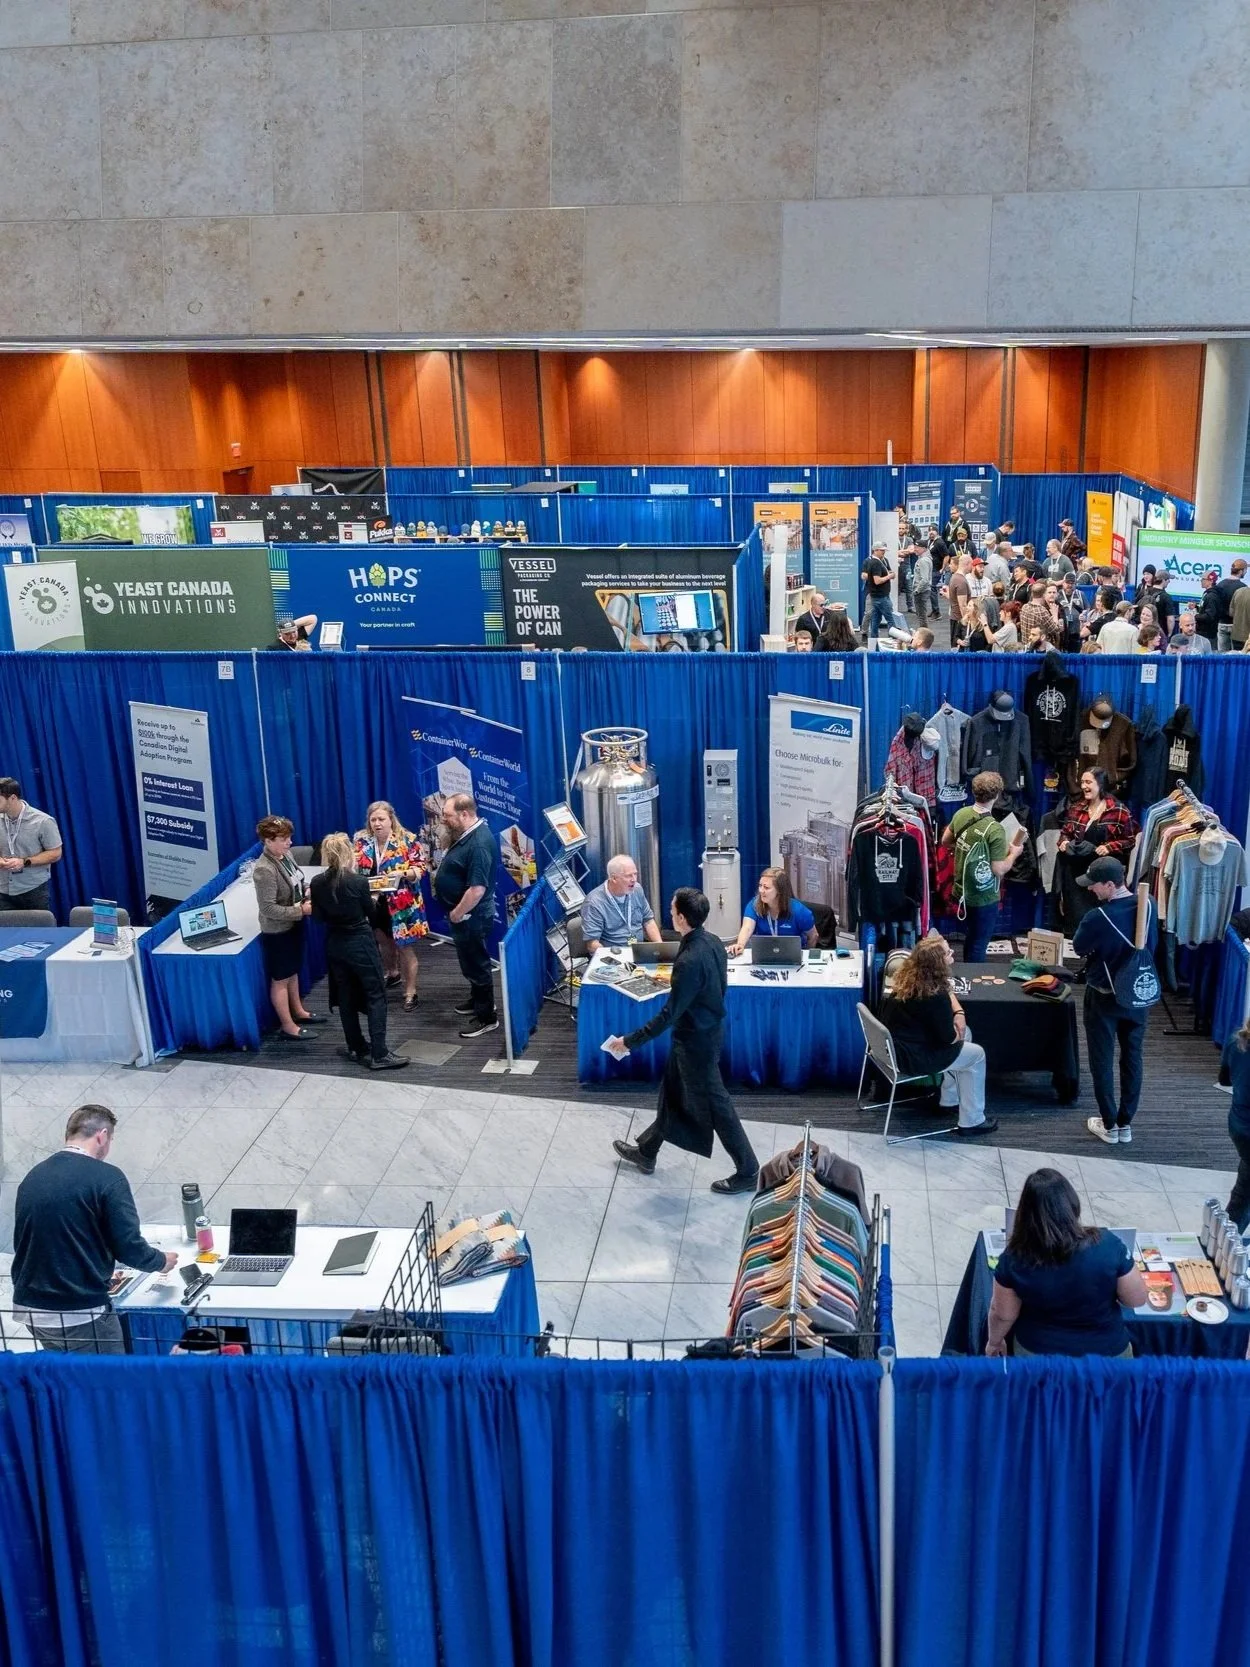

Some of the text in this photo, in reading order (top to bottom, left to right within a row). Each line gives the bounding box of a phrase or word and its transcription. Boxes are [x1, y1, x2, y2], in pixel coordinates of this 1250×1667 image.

[1143, 534, 1177, 544] INDUSTRY
[1179, 535, 1214, 546] MINGLER
[510, 560, 553, 570] VESSEL
[1166, 553, 1222, 577] Acera
[19, 577, 69, 601] YEAST CANADA
[113, 581, 234, 597] YEAST CANADA
[512, 588, 539, 603] THE
[355, 592, 417, 604] CONNECT
[21, 603, 71, 626] INNOVATIONS
[119, 599, 236, 615] INNOVATIONS
[514, 605, 560, 620] POWER
[516, 621, 562, 636] OF CAN
[137, 718, 160, 728] Receive
[822, 723, 851, 736] Linde
[156, 731, 179, 743] through
[180, 734, 189, 743] the
[422, 732, 468, 750] ContainerWor
[139, 739, 188, 754] Canadian Digital
[140, 750, 192, 764] Adoption Program
[478, 750, 521, 773] ContainerWorld
[775, 749, 844, 768] Choose Microbulk for:
[144, 777, 194, 792] 0% Interest Loan
[483, 771, 500, 785] From
[500, 777, 510, 789] the
[478, 780, 497, 795] World
[496, 787, 504, 797] to
[503, 791, 516, 803] your
[507, 802, 522, 816] Door
[146, 814, 168, 826] $7,300
[169, 819, 194, 833] Subsidy
